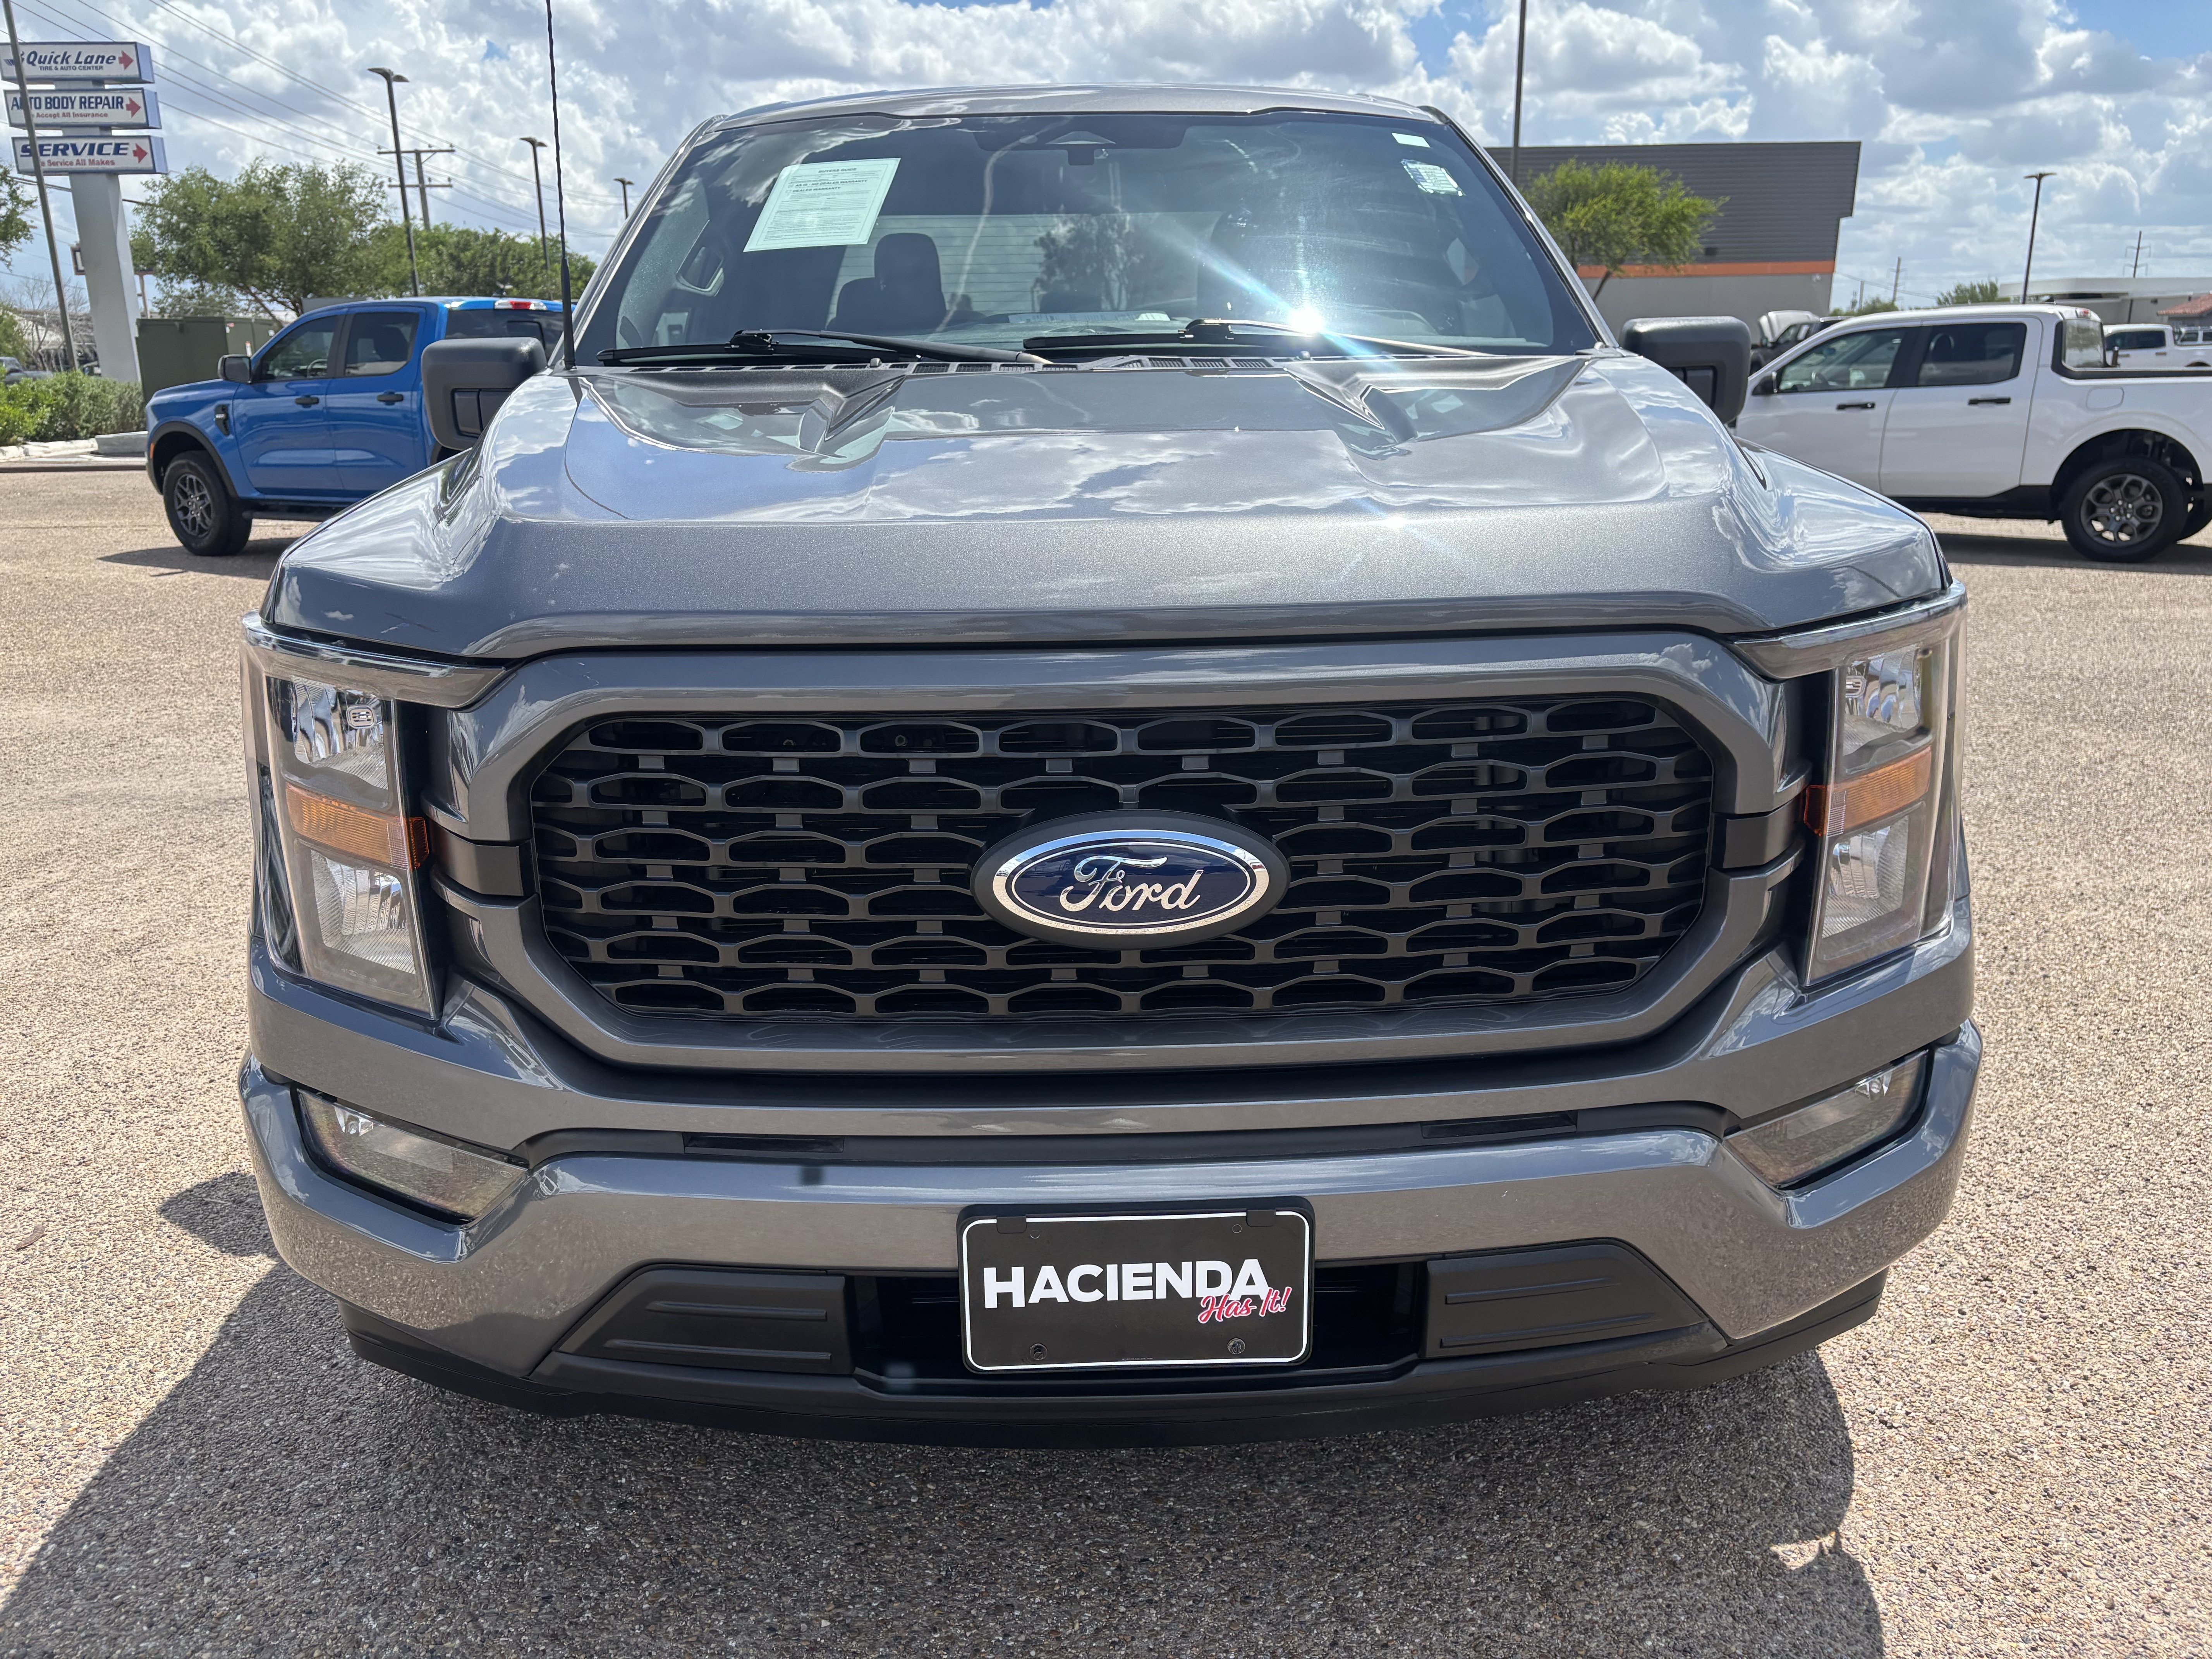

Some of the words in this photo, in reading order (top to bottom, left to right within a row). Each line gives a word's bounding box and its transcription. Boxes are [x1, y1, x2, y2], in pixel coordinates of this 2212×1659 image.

[26, 51, 72, 67] Quick
[74, 51, 116, 65] Lane
[45, 96, 77, 110] BODY
[79, 96, 124, 109] REPAIR
[20, 143, 129, 157] SERVICE
[1060, 855, 1203, 912] Ford
[983, 1259, 1270, 1309] HACIENDA
[1197, 1293, 1257, 1324] Has
[1259, 1286, 1292, 1317] It!
